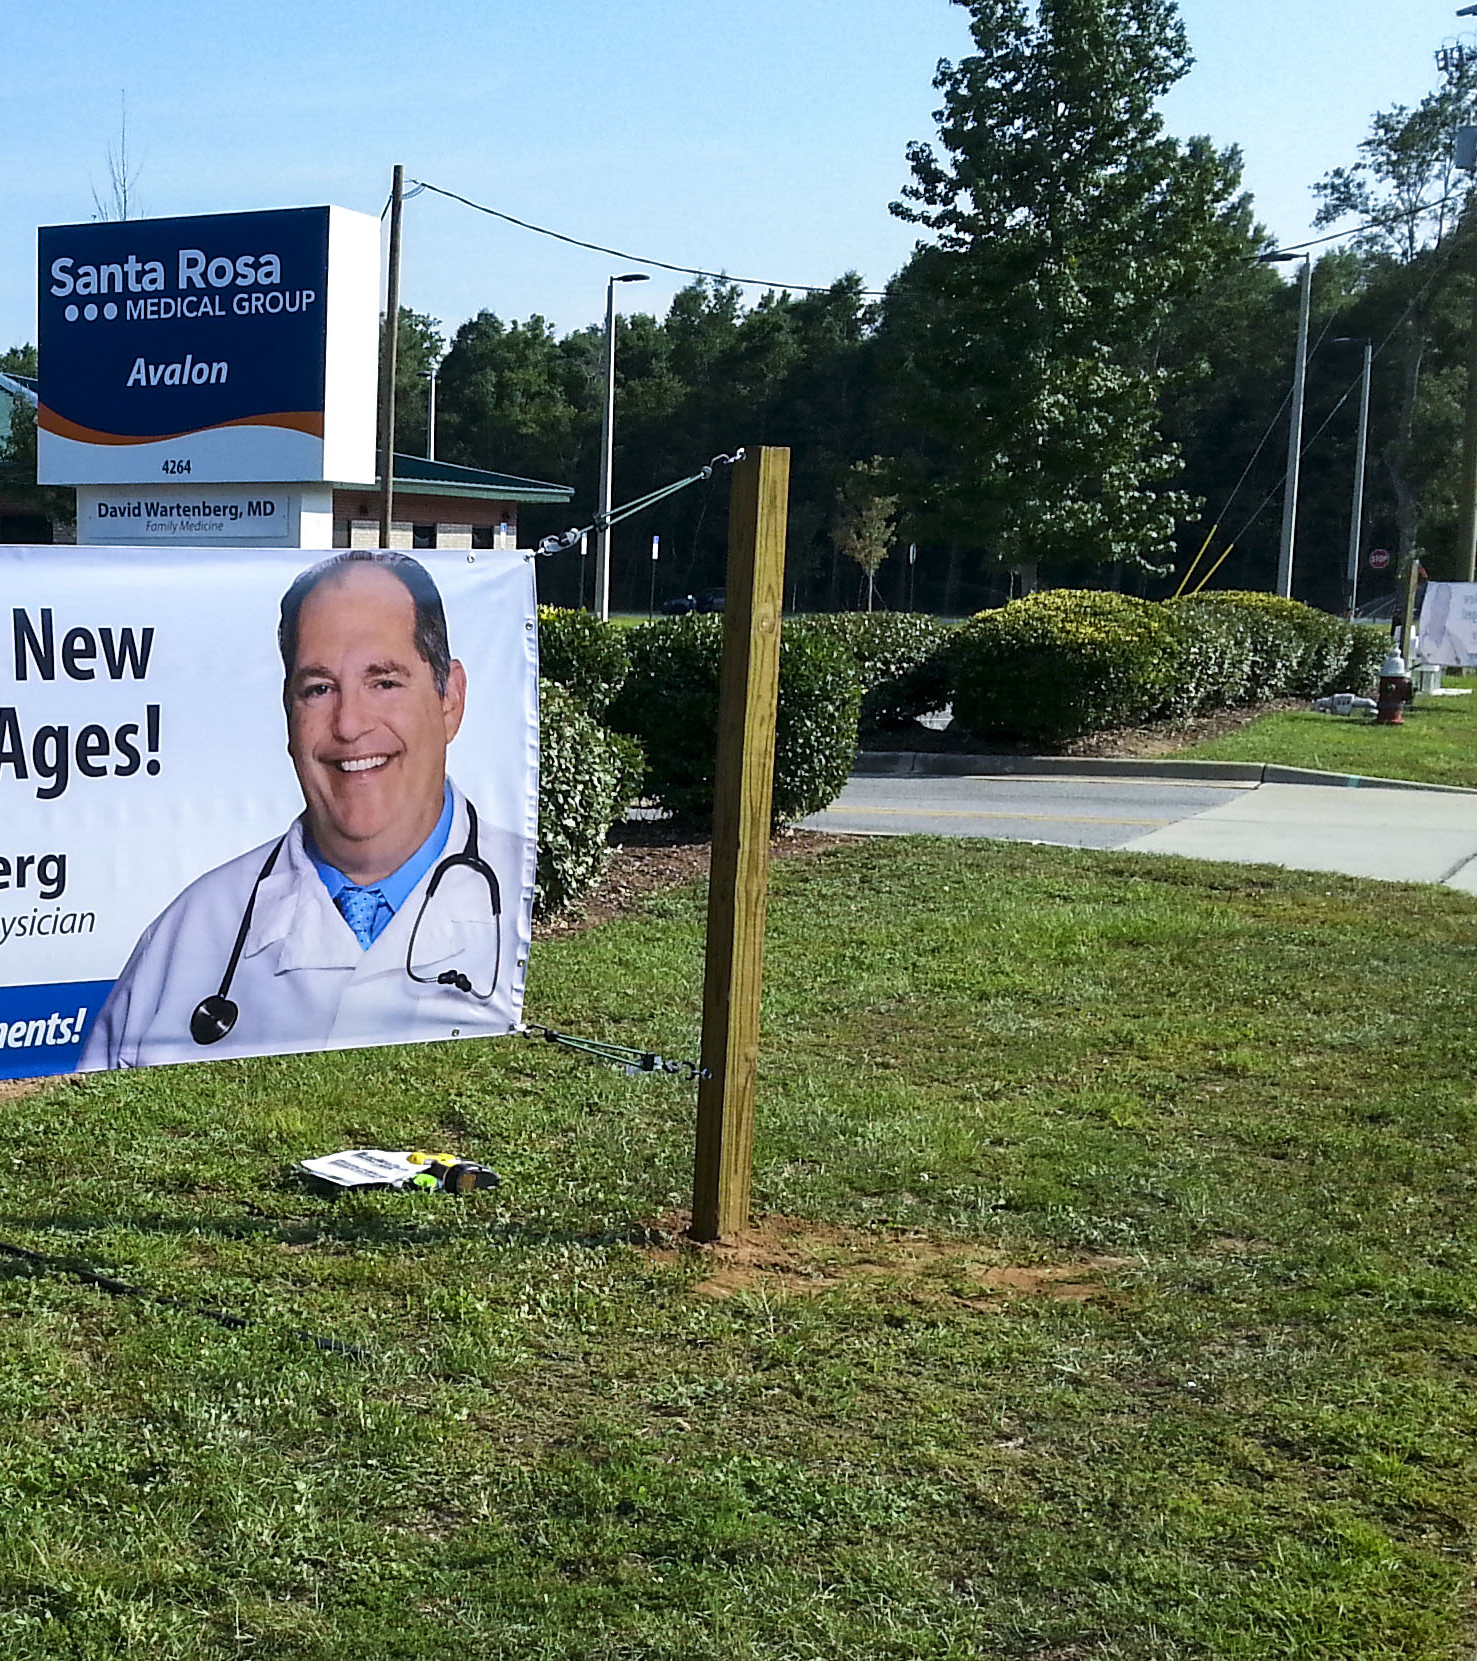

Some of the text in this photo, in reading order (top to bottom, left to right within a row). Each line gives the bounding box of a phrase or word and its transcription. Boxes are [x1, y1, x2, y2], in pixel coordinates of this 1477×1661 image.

[50, 249, 281, 297] Santa Rosa
[126, 290, 316, 321] MEDICAL GROUP
[126, 354, 229, 387] Avalon
[162, 460, 192, 475] 4264
[97, 500, 276, 521] David Wartenberg, MD
[145, 519, 225, 534] Family Medicine
[1371, 555, 1388, 564] STOP
[12, 607, 156, 681] New
